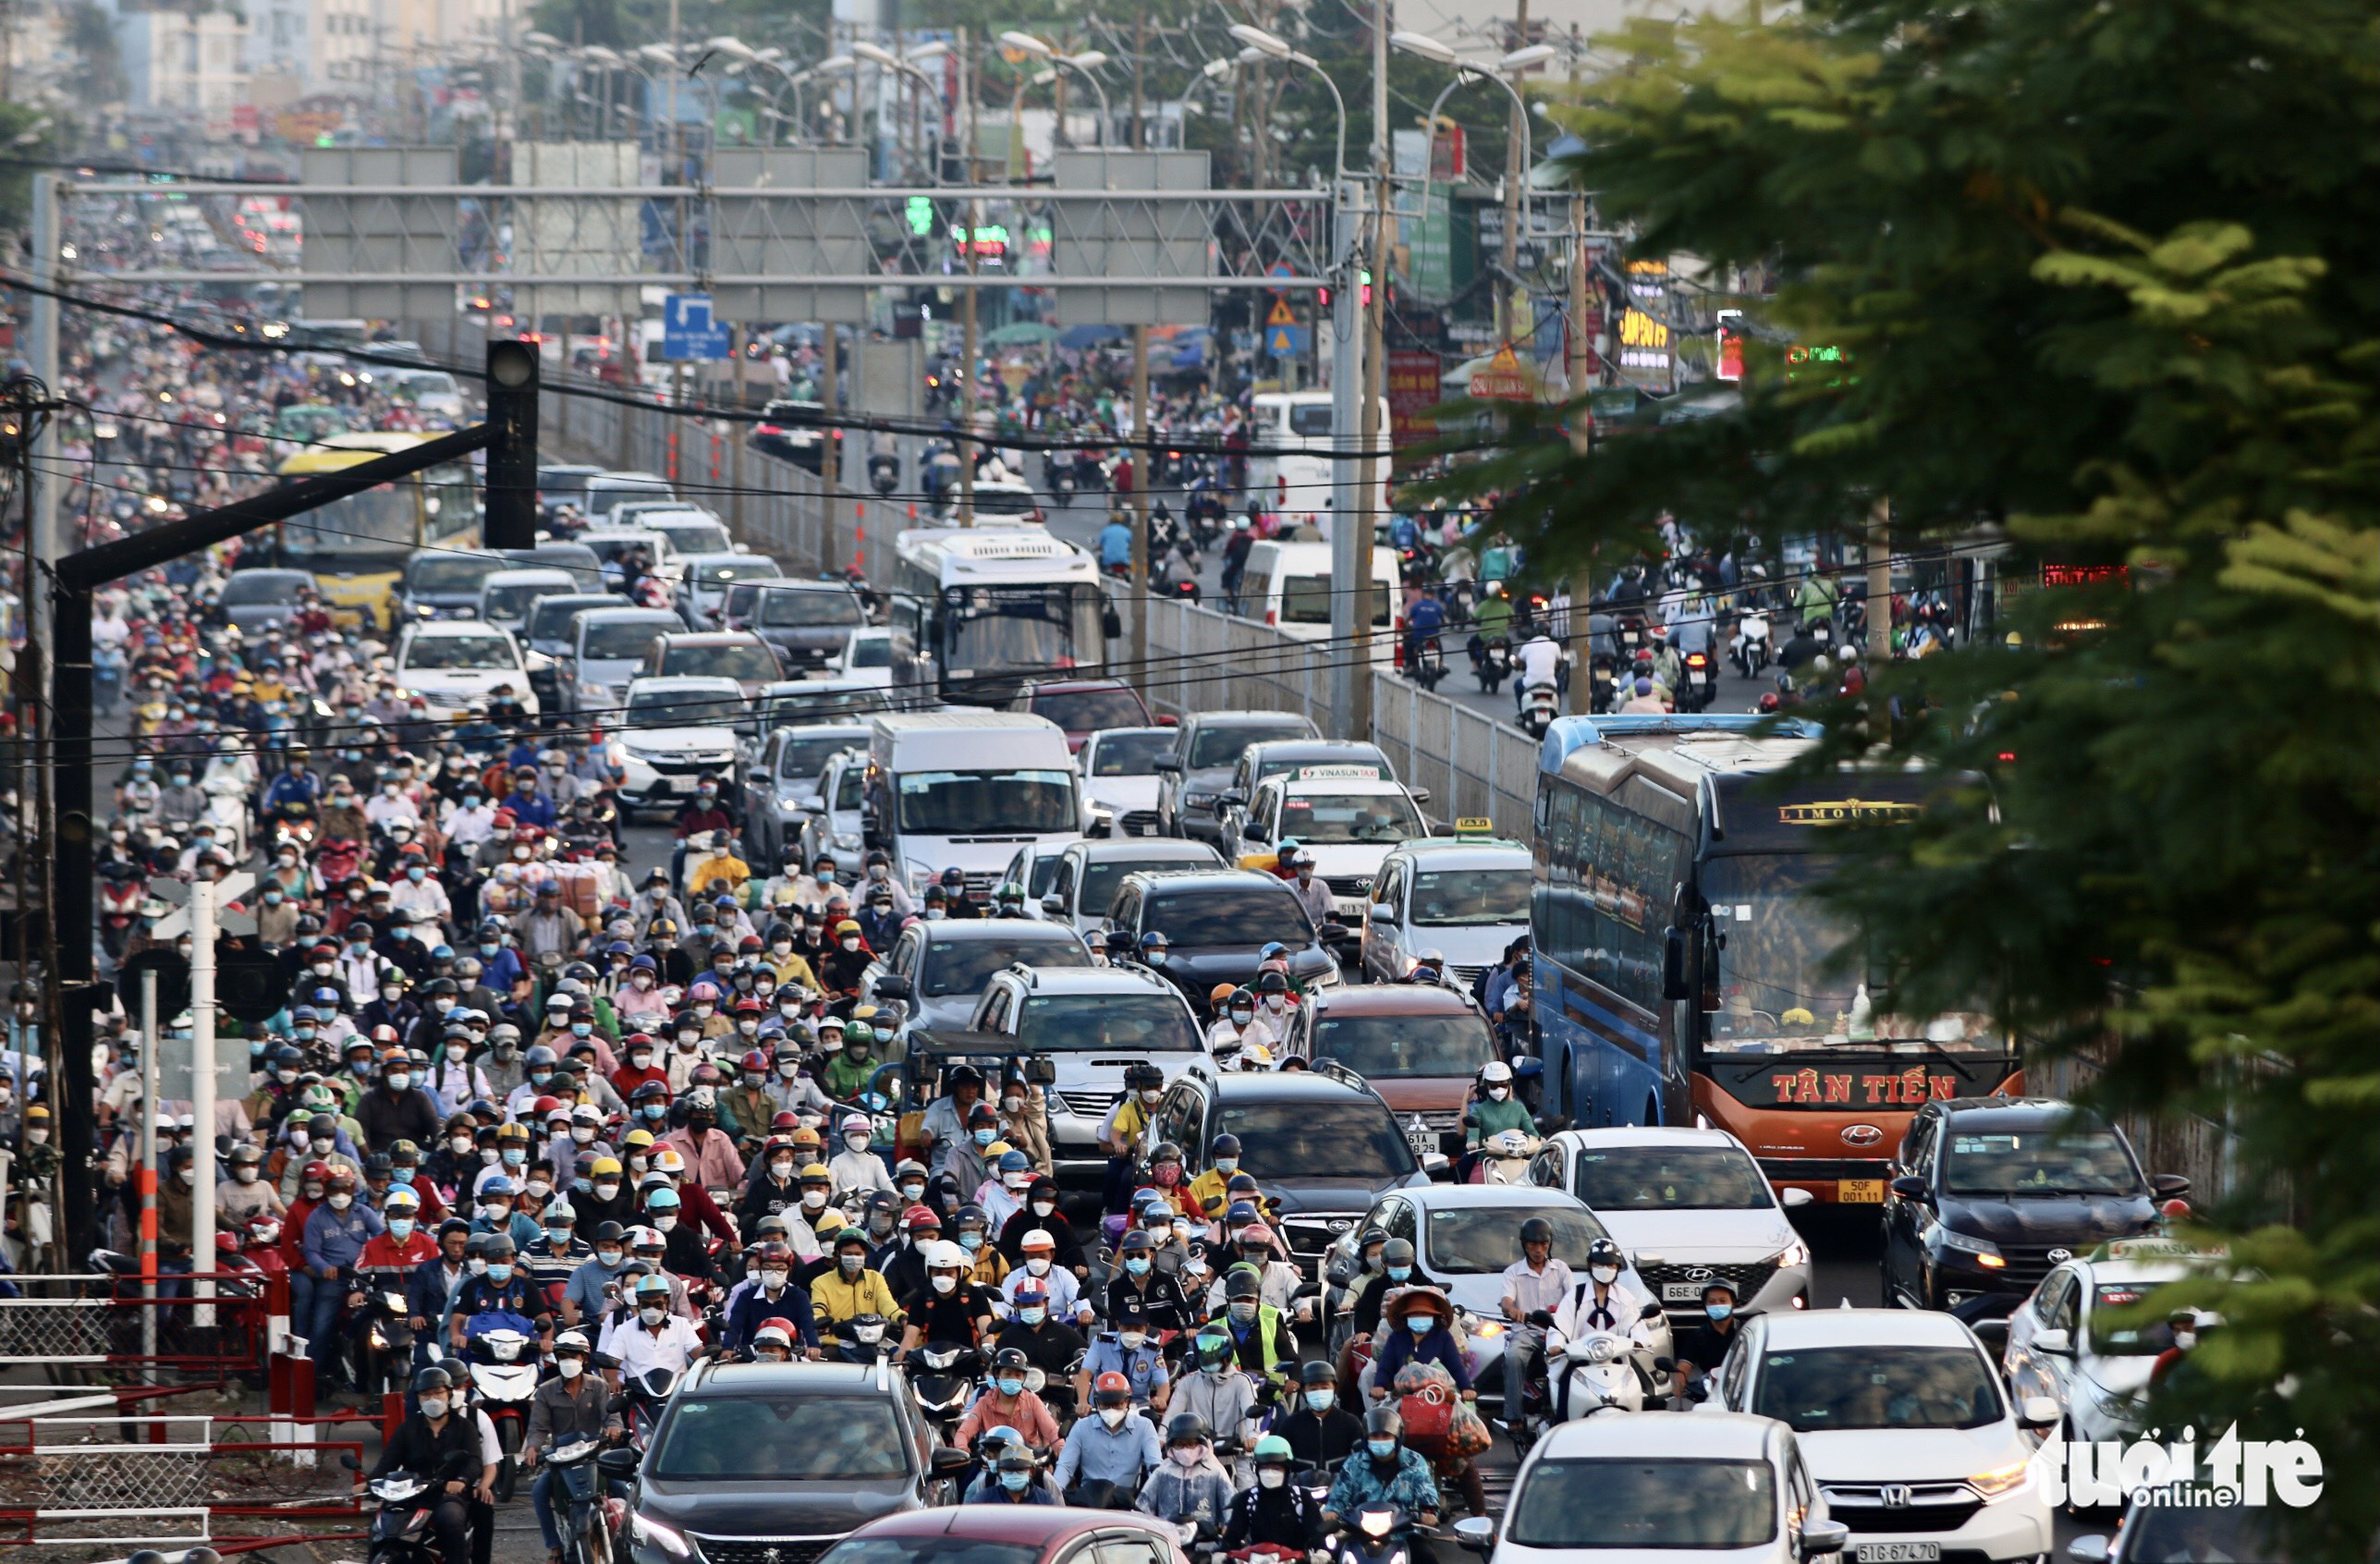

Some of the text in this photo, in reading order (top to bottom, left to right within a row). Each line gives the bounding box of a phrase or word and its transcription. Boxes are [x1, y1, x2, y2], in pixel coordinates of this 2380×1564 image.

[1320, 768, 1378, 778] VINASUN TAXI
[1780, 807, 1922, 821] LIMOUSIN
[1772, 1065, 1957, 1104] TÂN TIẾN
[1408, 1134, 1427, 1143] 61A
[1411, 1143, 1435, 1154] 8.29
[1851, 1180, 1871, 1191] 50F
[1843, 1191, 1878, 1202] 001.11
